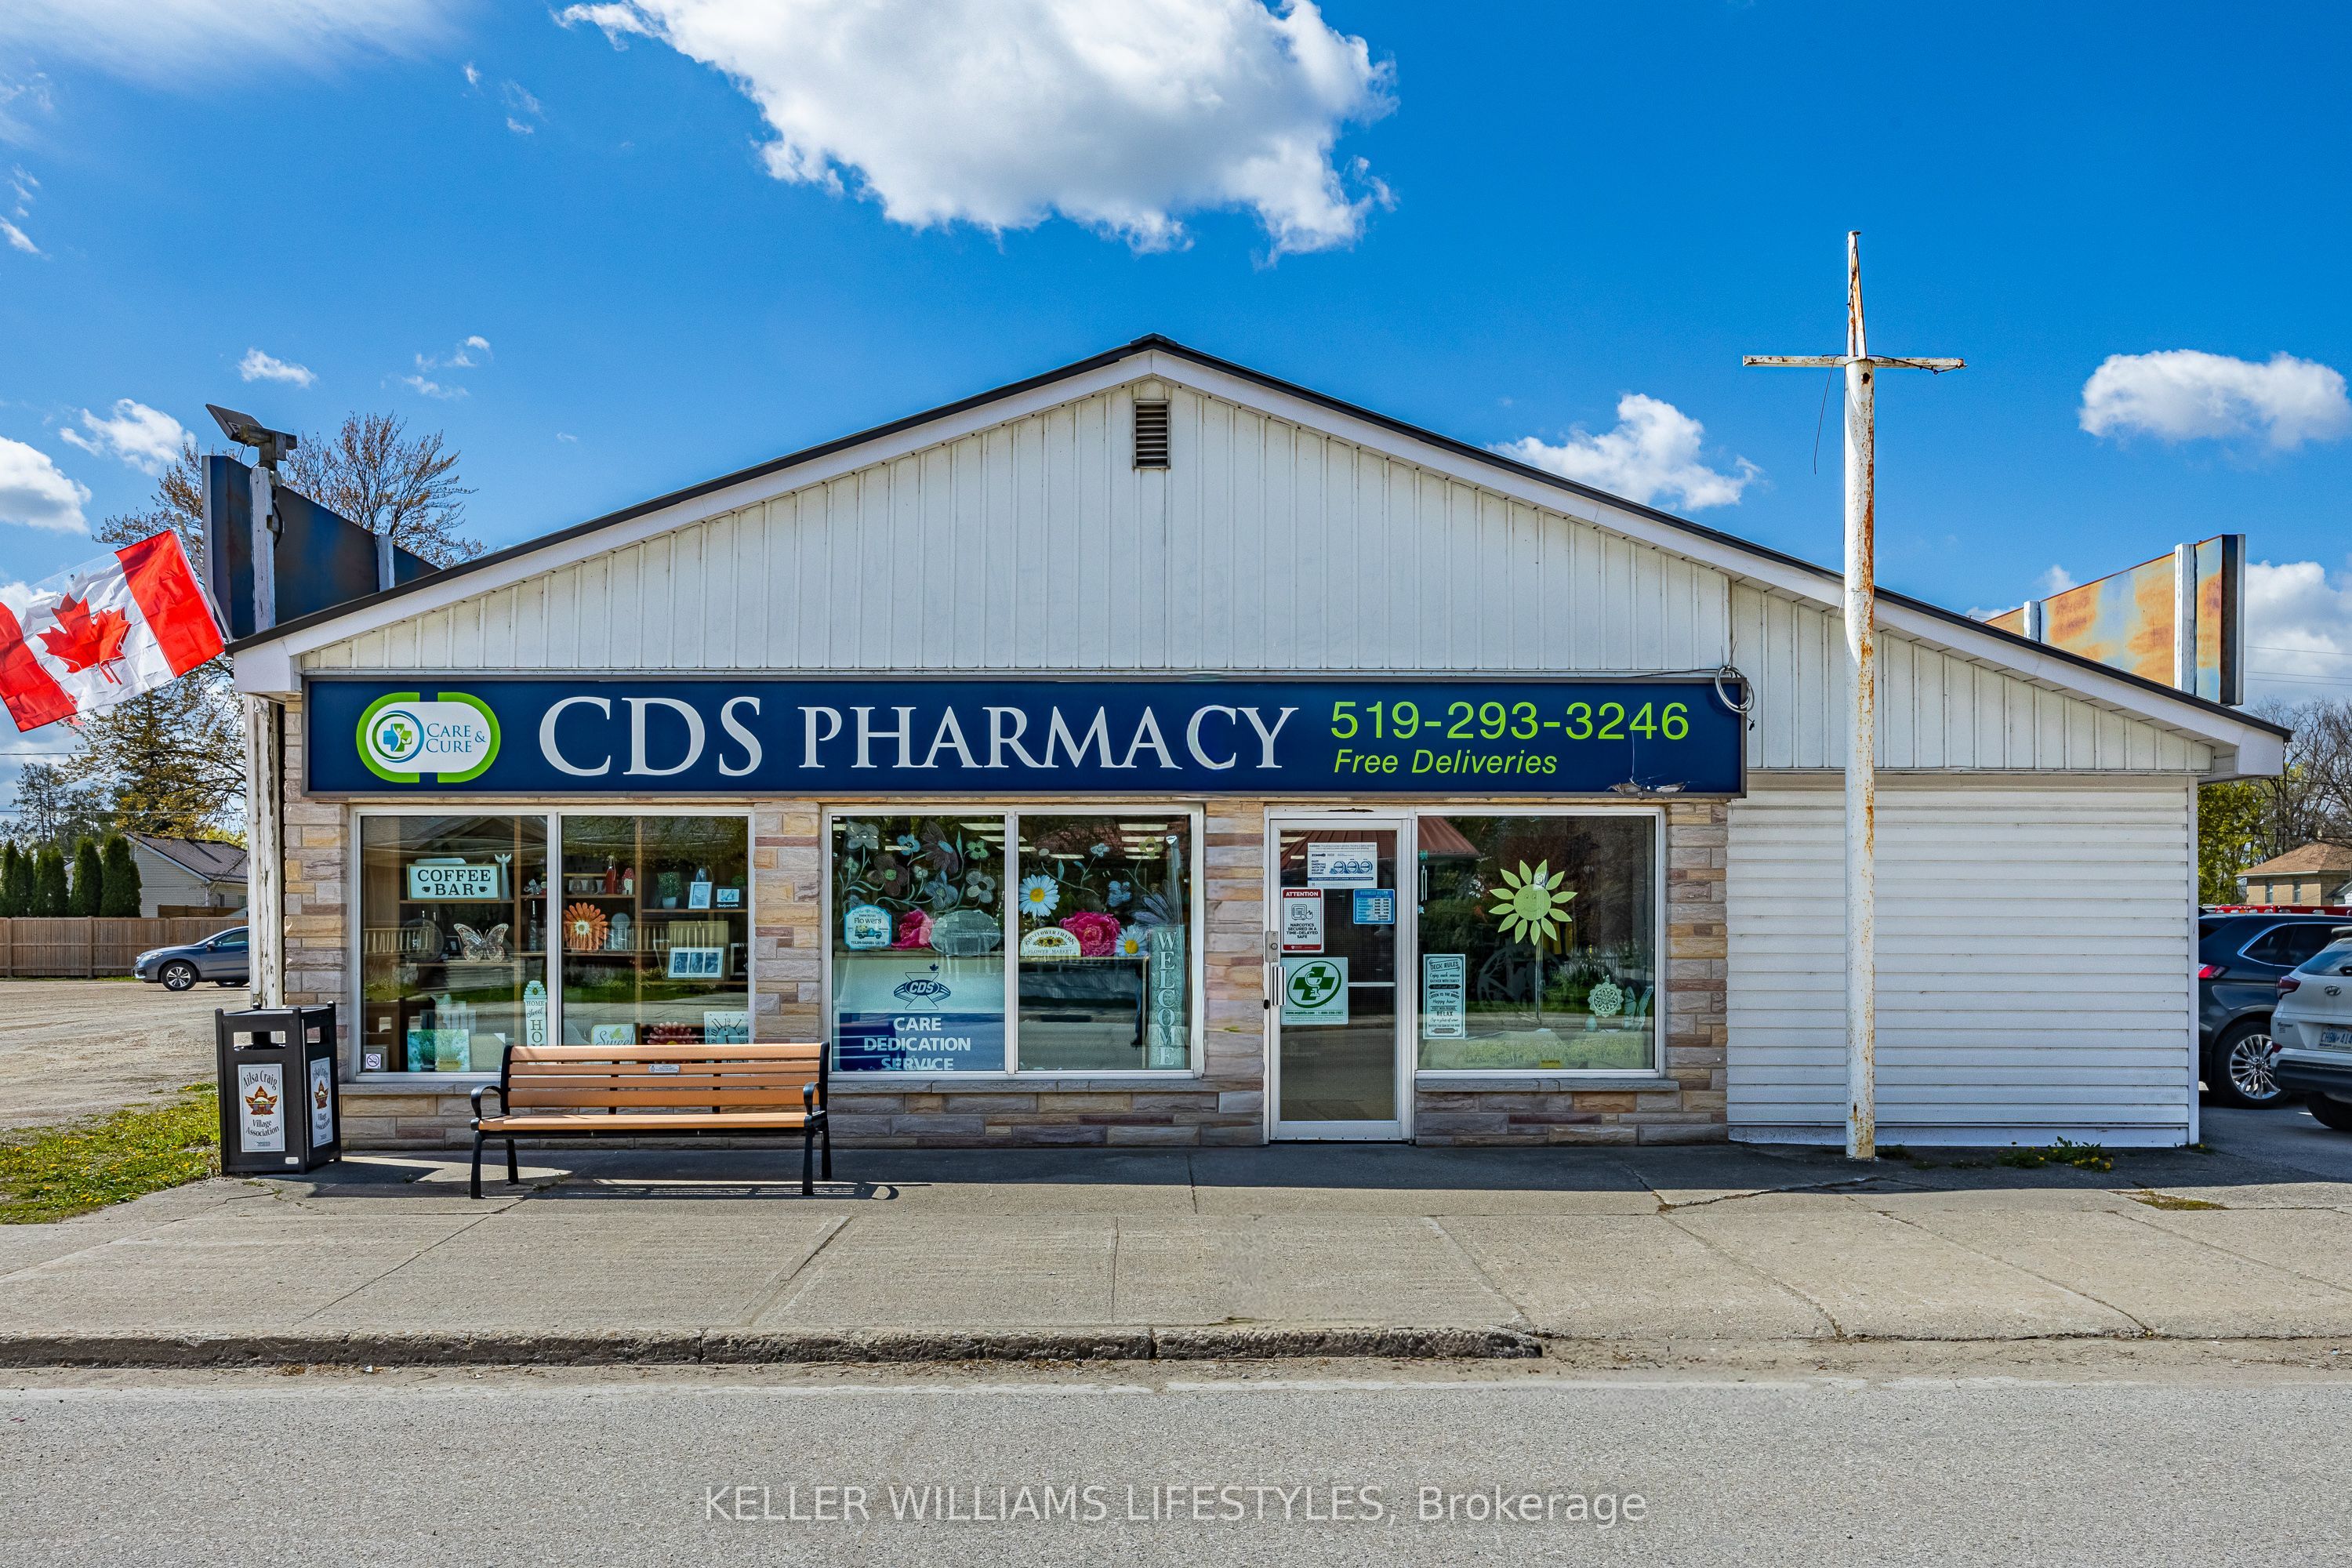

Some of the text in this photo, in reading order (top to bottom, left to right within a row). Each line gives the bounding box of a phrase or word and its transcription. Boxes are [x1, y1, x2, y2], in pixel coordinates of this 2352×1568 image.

[1331, 701, 1689, 739] 519-293-3246
[474, 731, 487, 743] &
[539, 696, 1299, 776] CDS PHARMACY
[1334, 749, 1557, 775] Free Deliveries
[417, 869, 491, 882] COFFEE
[434, 884, 475, 896] BAR
[909, 982, 935, 993] CDS
[1157, 931, 1177, 1066] WELCOME
[894, 1017, 942, 1031] CARE
[530, 1019, 543, 1046] HO
[864, 1037, 971, 1051] DEDICATION
[880, 1058, 954, 1071] SERVICE
[243, 1069, 278, 1091] Ailsa Craig
[245, 1125, 280, 1137] Association
[252, 1119, 272, 1129] Village
